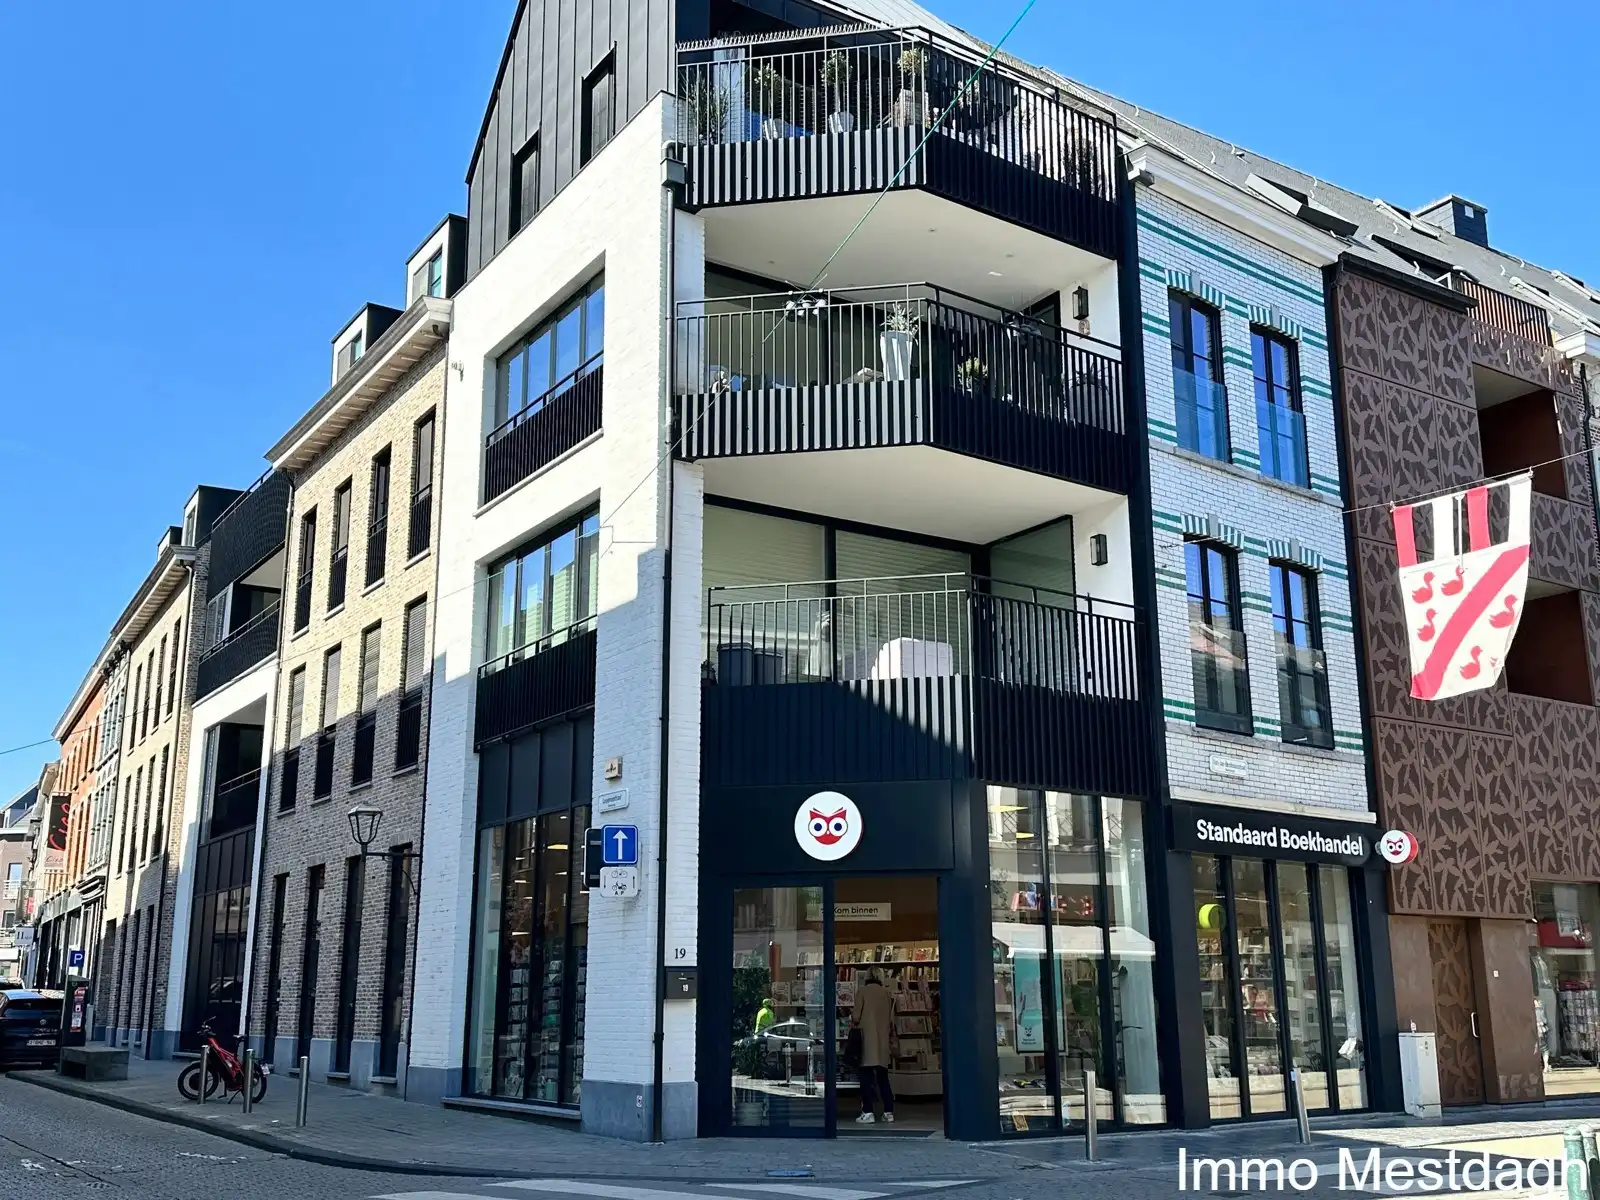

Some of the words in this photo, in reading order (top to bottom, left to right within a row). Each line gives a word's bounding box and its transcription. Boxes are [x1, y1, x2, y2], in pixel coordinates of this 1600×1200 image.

[1196, 819, 1277, 848] Standaard
[1280, 827, 1363, 856] Boekhandel
[852, 906, 878, 914] binnen
[73, 953, 83, 964] P
[674, 947, 687, 960] 19
